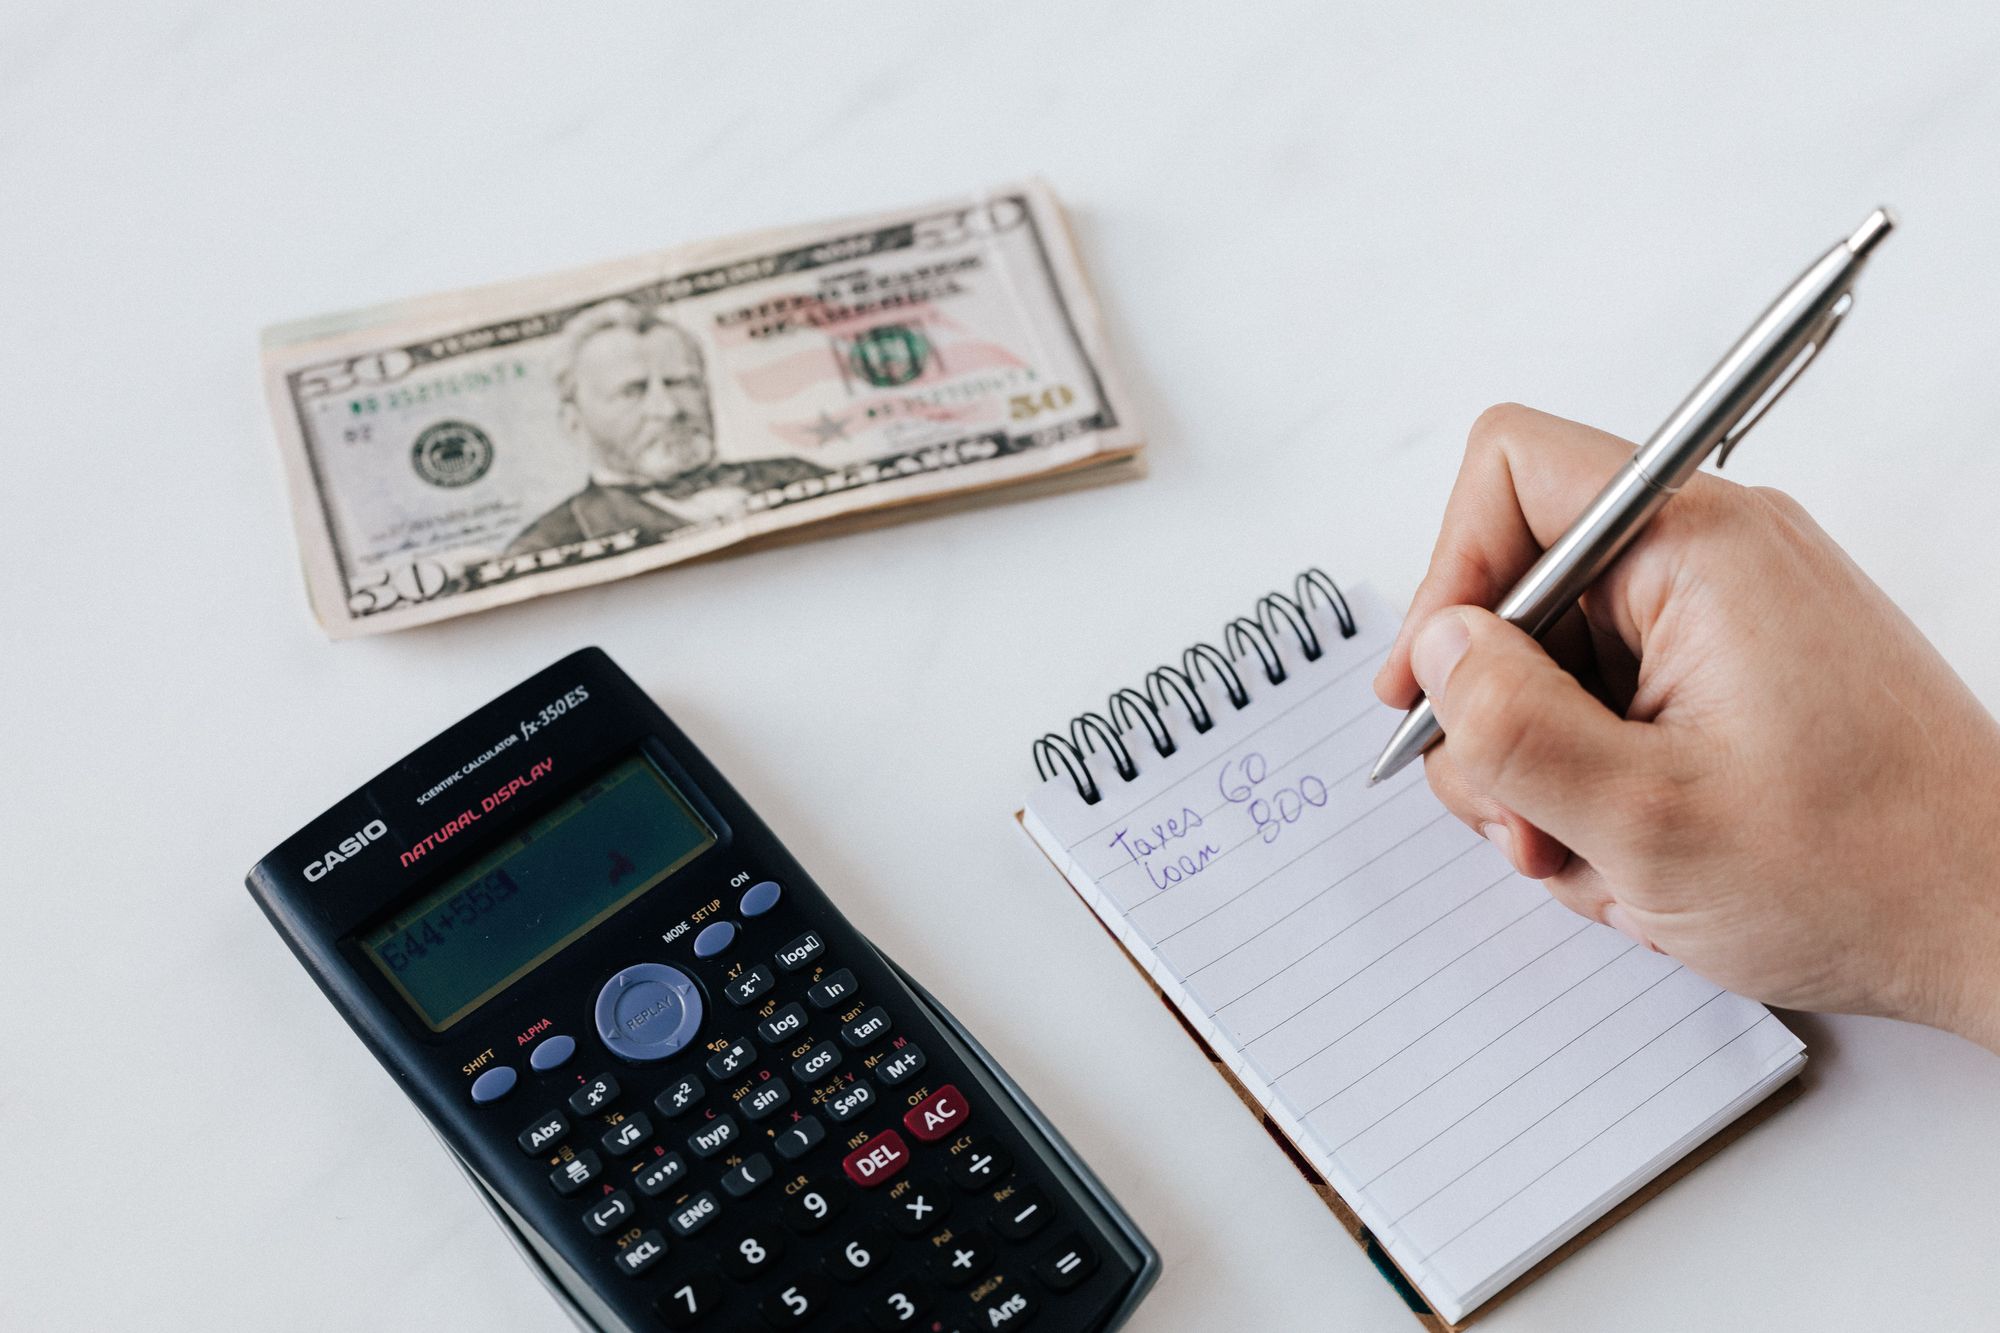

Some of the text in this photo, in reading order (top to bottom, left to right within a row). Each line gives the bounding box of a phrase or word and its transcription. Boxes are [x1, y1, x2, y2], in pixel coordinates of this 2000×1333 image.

[1008, 384, 1074, 421] 50
[416, 685, 590, 806] SCIENTIFIC CALCULATOR fx-350ES
[1219, 752, 1267, 803] 60
[400, 757, 553, 868] NATURAL DISPLAY
[1249, 775, 1328, 844] 800
[302, 818, 388, 883] CASIO
[730, 871, 751, 889] ON
[661, 921, 691, 944] MODE
[626, 994, 672, 1030] REPLAY
[768, 1013, 799, 1036] log
[516, 1017, 552, 1046] ALPHA
[854, 1016, 884, 1039] tan
[462, 1048, 495, 1076] SHIFT
[805, 1050, 832, 1073] cos
[886, 1053, 917, 1079] M+
[752, 1088, 779, 1111] sin
[907, 1086, 930, 1106] OFF
[924, 1098, 957, 1131] AC
[530, 1120, 562, 1148] Abs
[696, 1124, 730, 1150] hyp
[847, 1130, 870, 1149] INS
[950, 1135, 973, 1155] nCr
[856, 1144, 901, 1177] DEL
[784, 1175, 809, 1195] CLR
[677, 1198, 714, 1229] ENG
[804, 1192, 828, 1218] 9
[617, 1228, 643, 1249] STO
[739, 1238, 766, 1264] 8
[625, 1241, 661, 1268] RCL
[845, 1241, 871, 1268] 6
[673, 1285, 697, 1313] 7
[781, 1286, 808, 1315] 5
[887, 1293, 915, 1321] 3
[987, 1293, 1027, 1328] Ans
